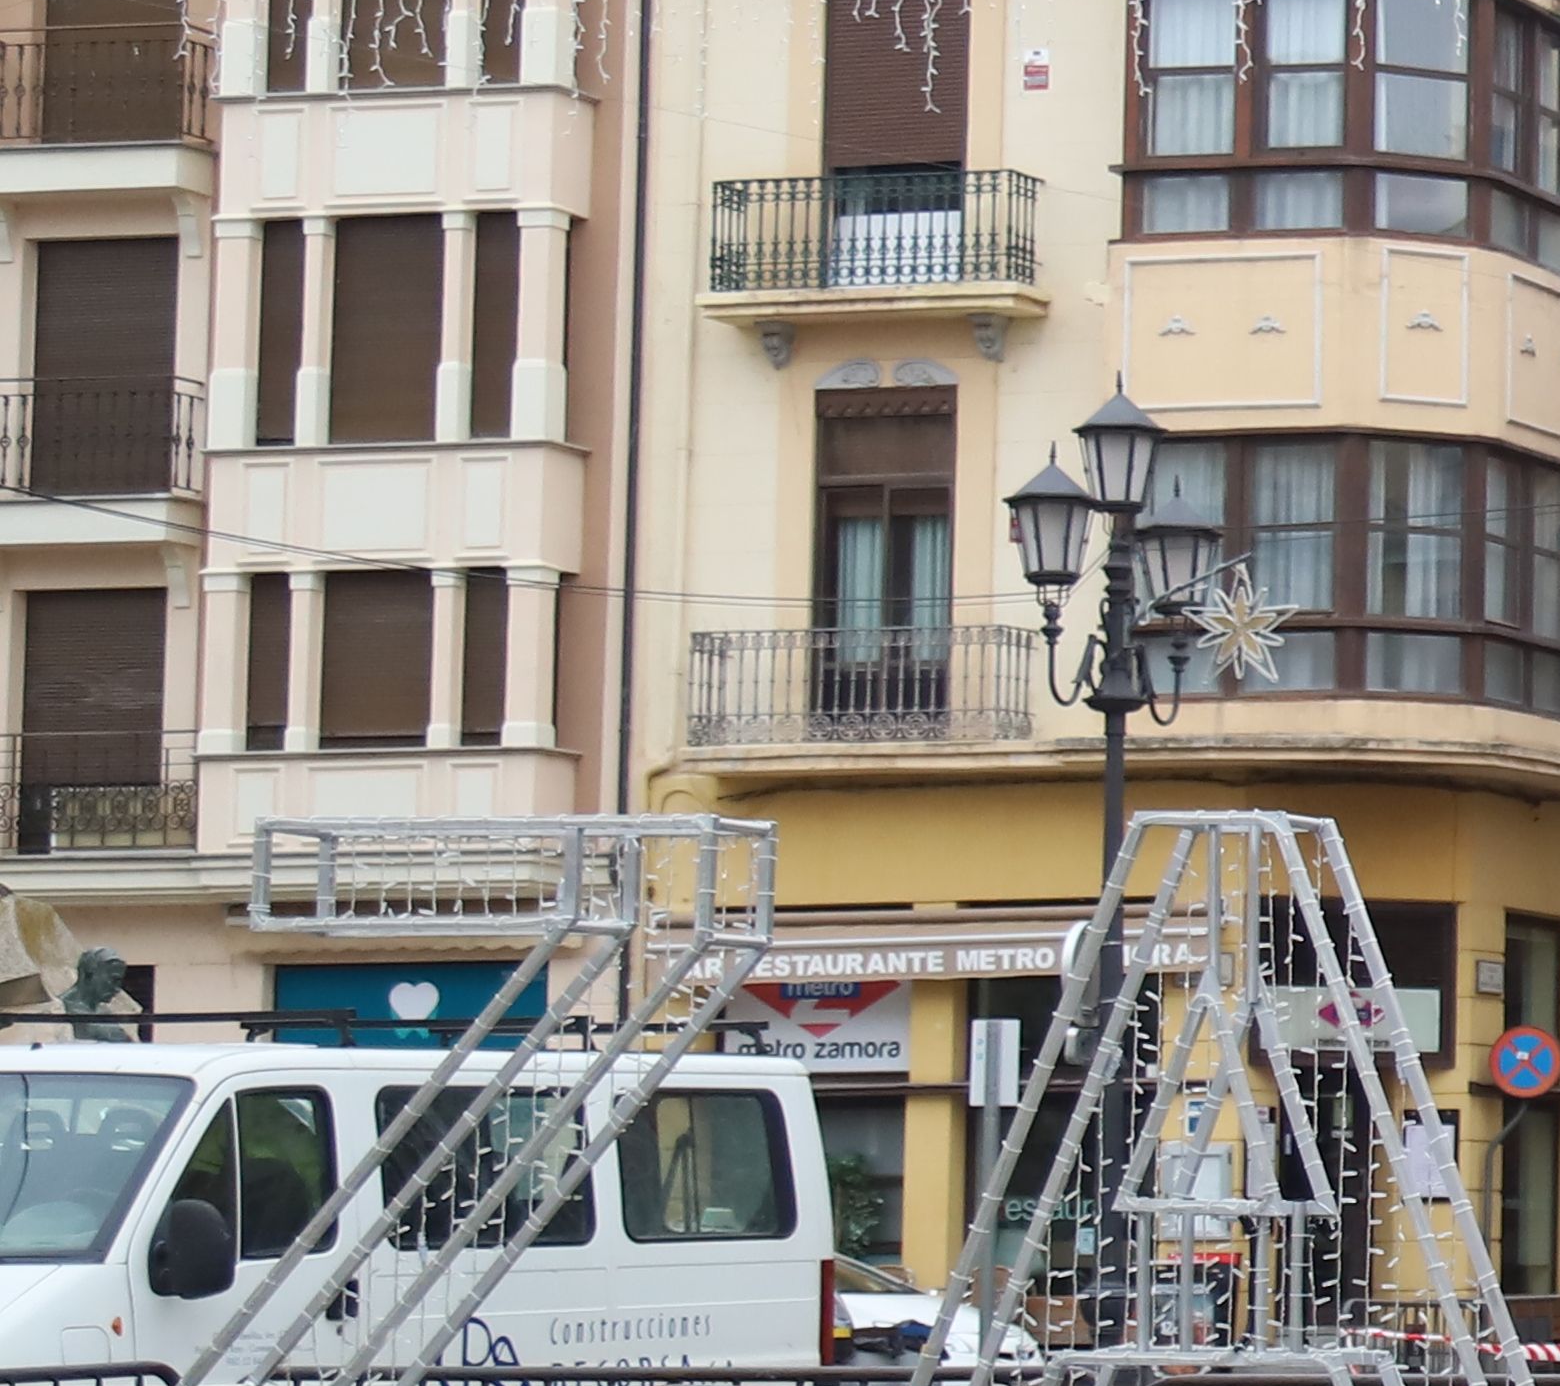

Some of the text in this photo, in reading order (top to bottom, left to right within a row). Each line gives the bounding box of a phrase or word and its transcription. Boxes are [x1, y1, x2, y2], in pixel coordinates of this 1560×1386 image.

[668, 947, 1056, 979] AR ESTAURANTE METRO
[814, 1041, 901, 1059] zamora
[550, 1314, 712, 1345] Construcciones
